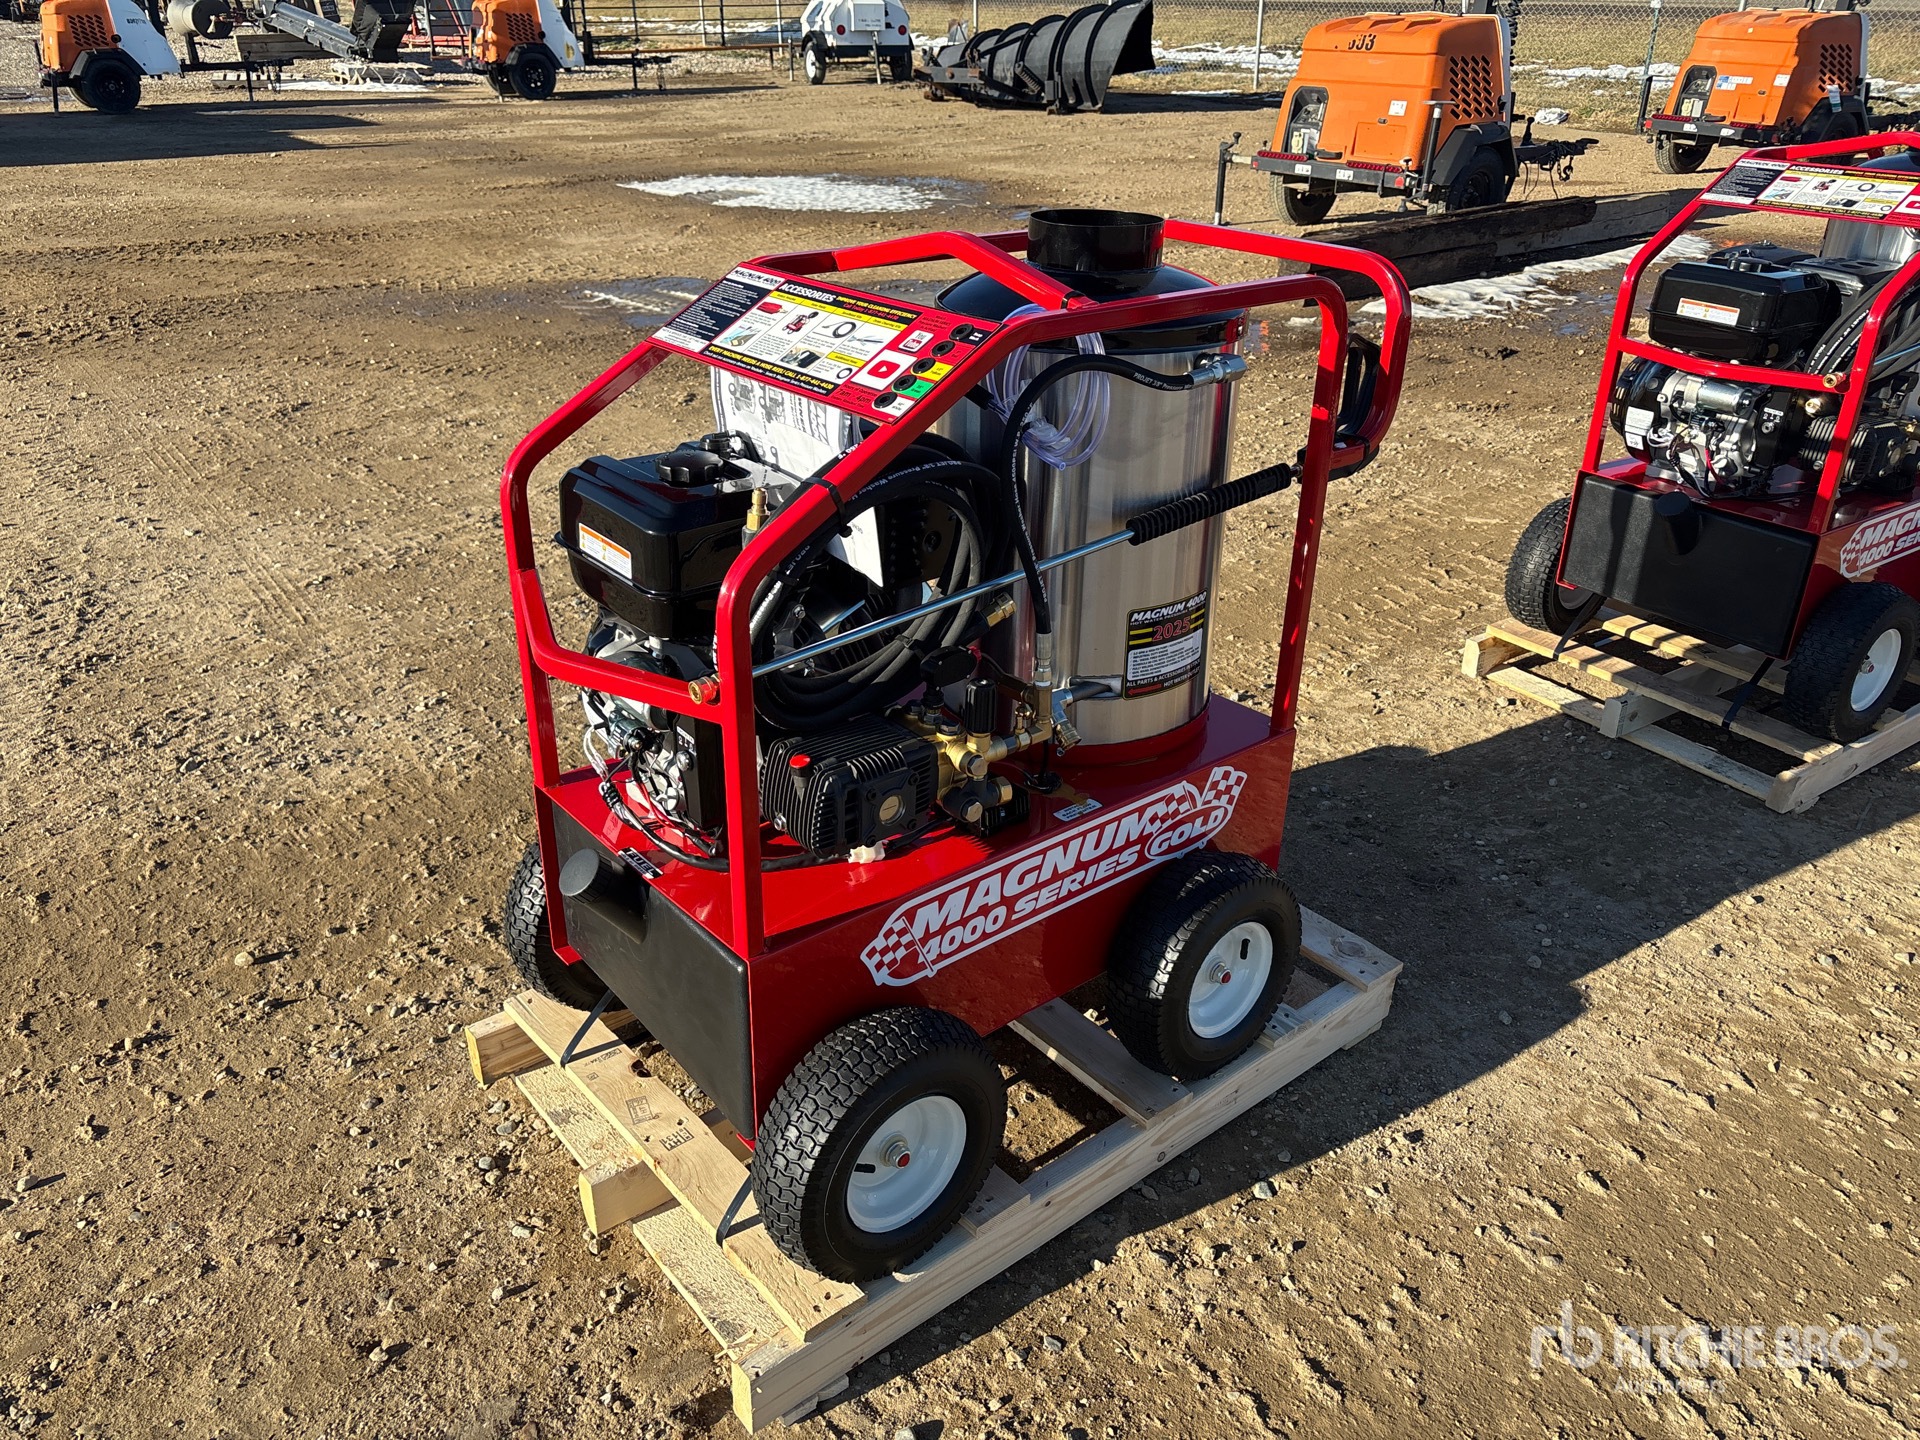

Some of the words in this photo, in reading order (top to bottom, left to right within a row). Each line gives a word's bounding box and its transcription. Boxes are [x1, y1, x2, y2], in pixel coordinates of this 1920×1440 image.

[1790, 165, 1843, 175] ACCESSORIES
[778, 283, 837, 302] ACCESSORIES
[866, 303, 891, 312] CLEANING
[888, 309, 917, 319] EFFICIENCY
[707, 345, 725, 353] EVERY
[721, 350, 744, 360] MACHINE
[740, 356, 757, 364] NEEDS
[888, 465, 921, 481] Pressure
[857, 477, 887, 495] Washer
[1857, 540, 1895, 566] 4000
[1130, 601, 1184, 621] MAGNUM
[1187, 592, 1205, 606] 4000
[1152, 616, 1189, 641] 2025
[1159, 666, 1185, 679] ACCESSORIES
[1163, 679, 1172, 687] HOT
[1173, 674, 1185, 683] WATER
[626, 849, 656, 876] FUEL
[910, 802, 1161, 938] MAGNUM
[917, 905, 1006, 963] 4000
[1011, 845, 1140, 921] SERIES
[1152, 805, 1227, 853] GOLD
